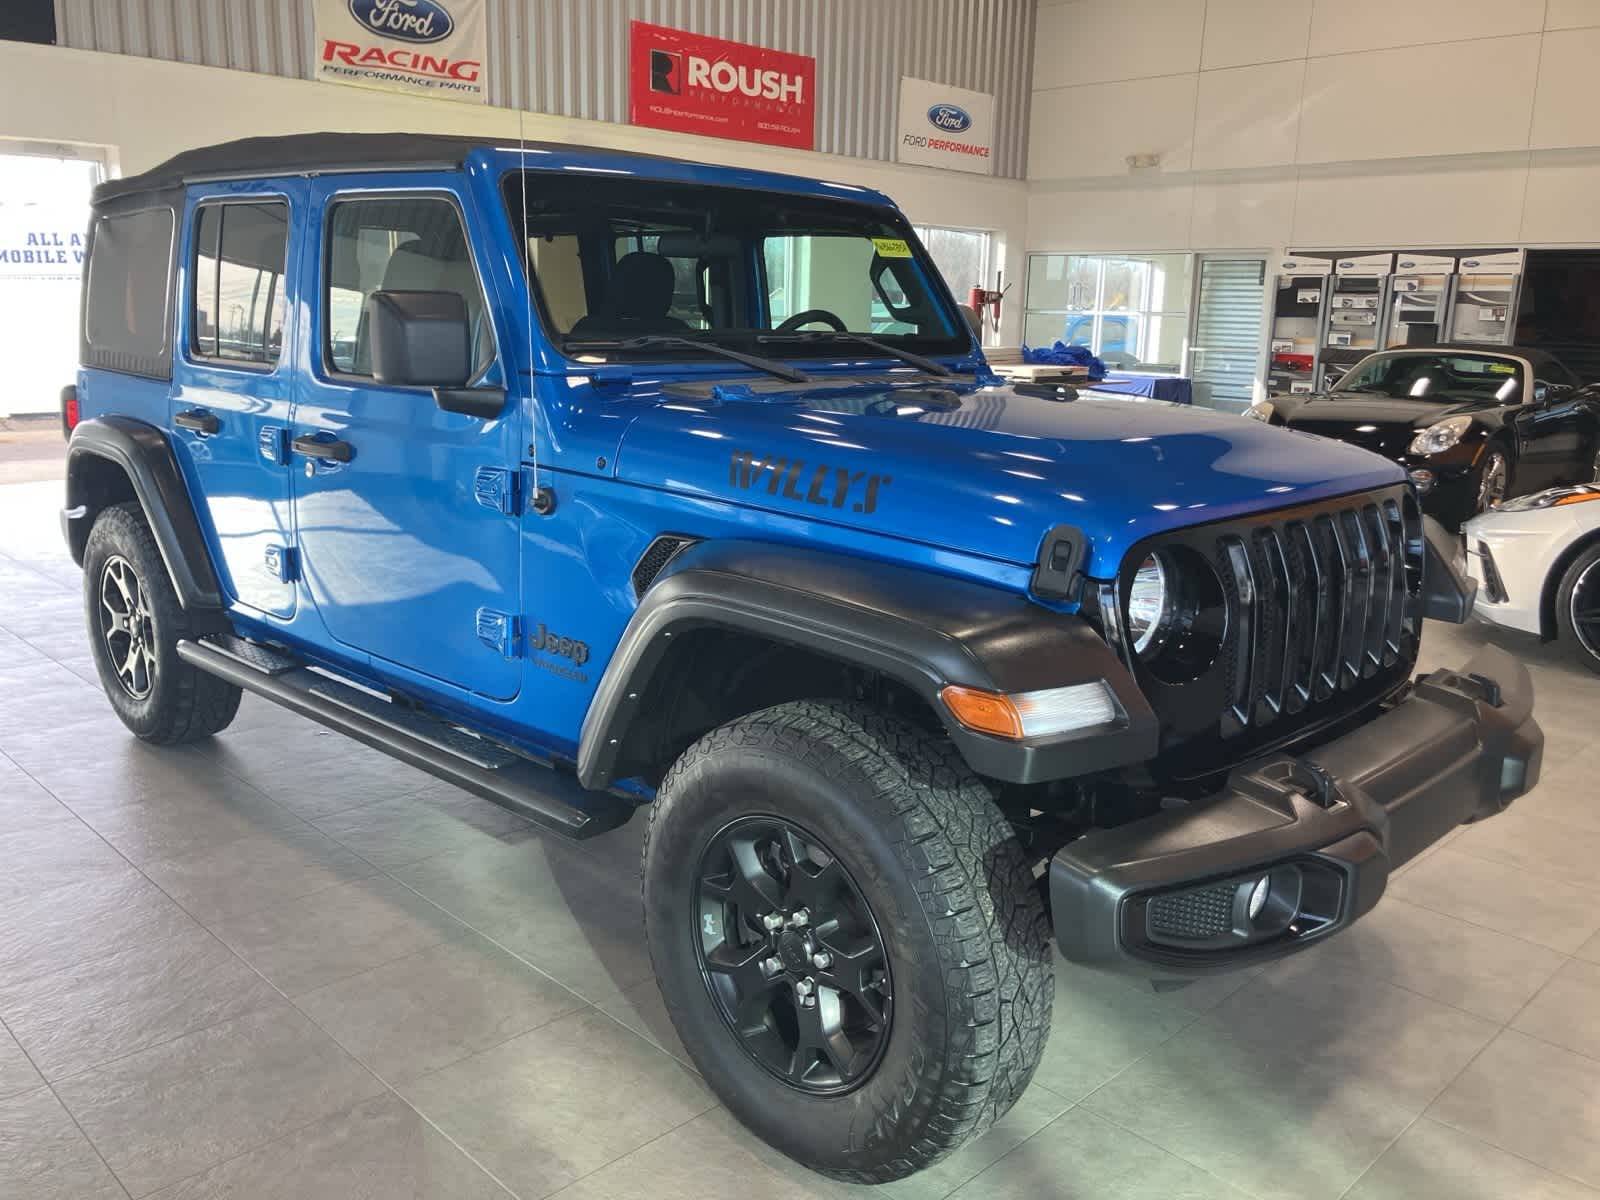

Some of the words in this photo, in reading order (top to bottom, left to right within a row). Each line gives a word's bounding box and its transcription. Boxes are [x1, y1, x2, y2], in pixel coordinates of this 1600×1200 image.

[369, 0, 434, 36] Ford
[322, 65, 434, 88] PERFORMANCE
[439, 82, 481, 93] PARTS
[323, 40, 481, 82] RACING
[687, 54, 804, 104] ROUSH
[935, 107, 964, 129] Ford
[902, 134, 928, 148] FORD
[927, 138, 990, 158] PERFORMANCE
[27, 232, 64, 246] ALL
[71, 232, 87, 246] A
[729, 448, 893, 515] WILLYS
[528, 623, 589, 668] Jeep
